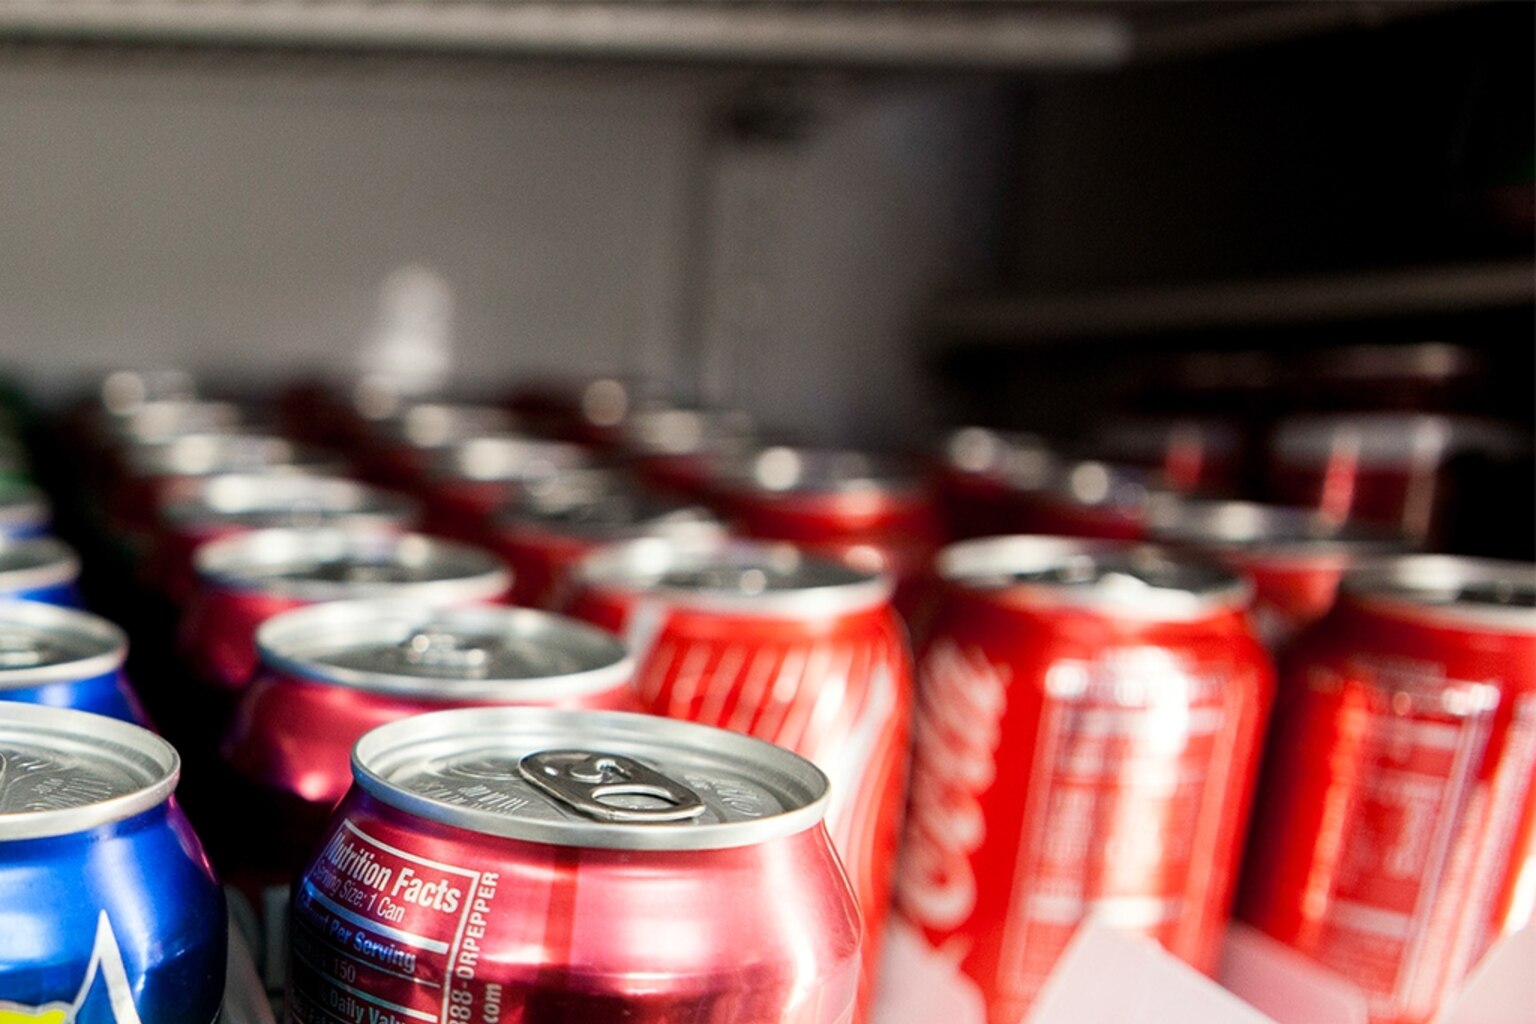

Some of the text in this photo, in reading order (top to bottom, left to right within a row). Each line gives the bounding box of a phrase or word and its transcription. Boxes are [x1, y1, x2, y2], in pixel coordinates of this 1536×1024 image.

[325, 832, 393, 892] Nutrition
[392, 867, 463, 914] Facts
[339, 878, 366, 909] Size:
[367, 892, 377, 912] 1
[376, 896, 406, 924] Can
[353, 931, 417, 974] Serving
